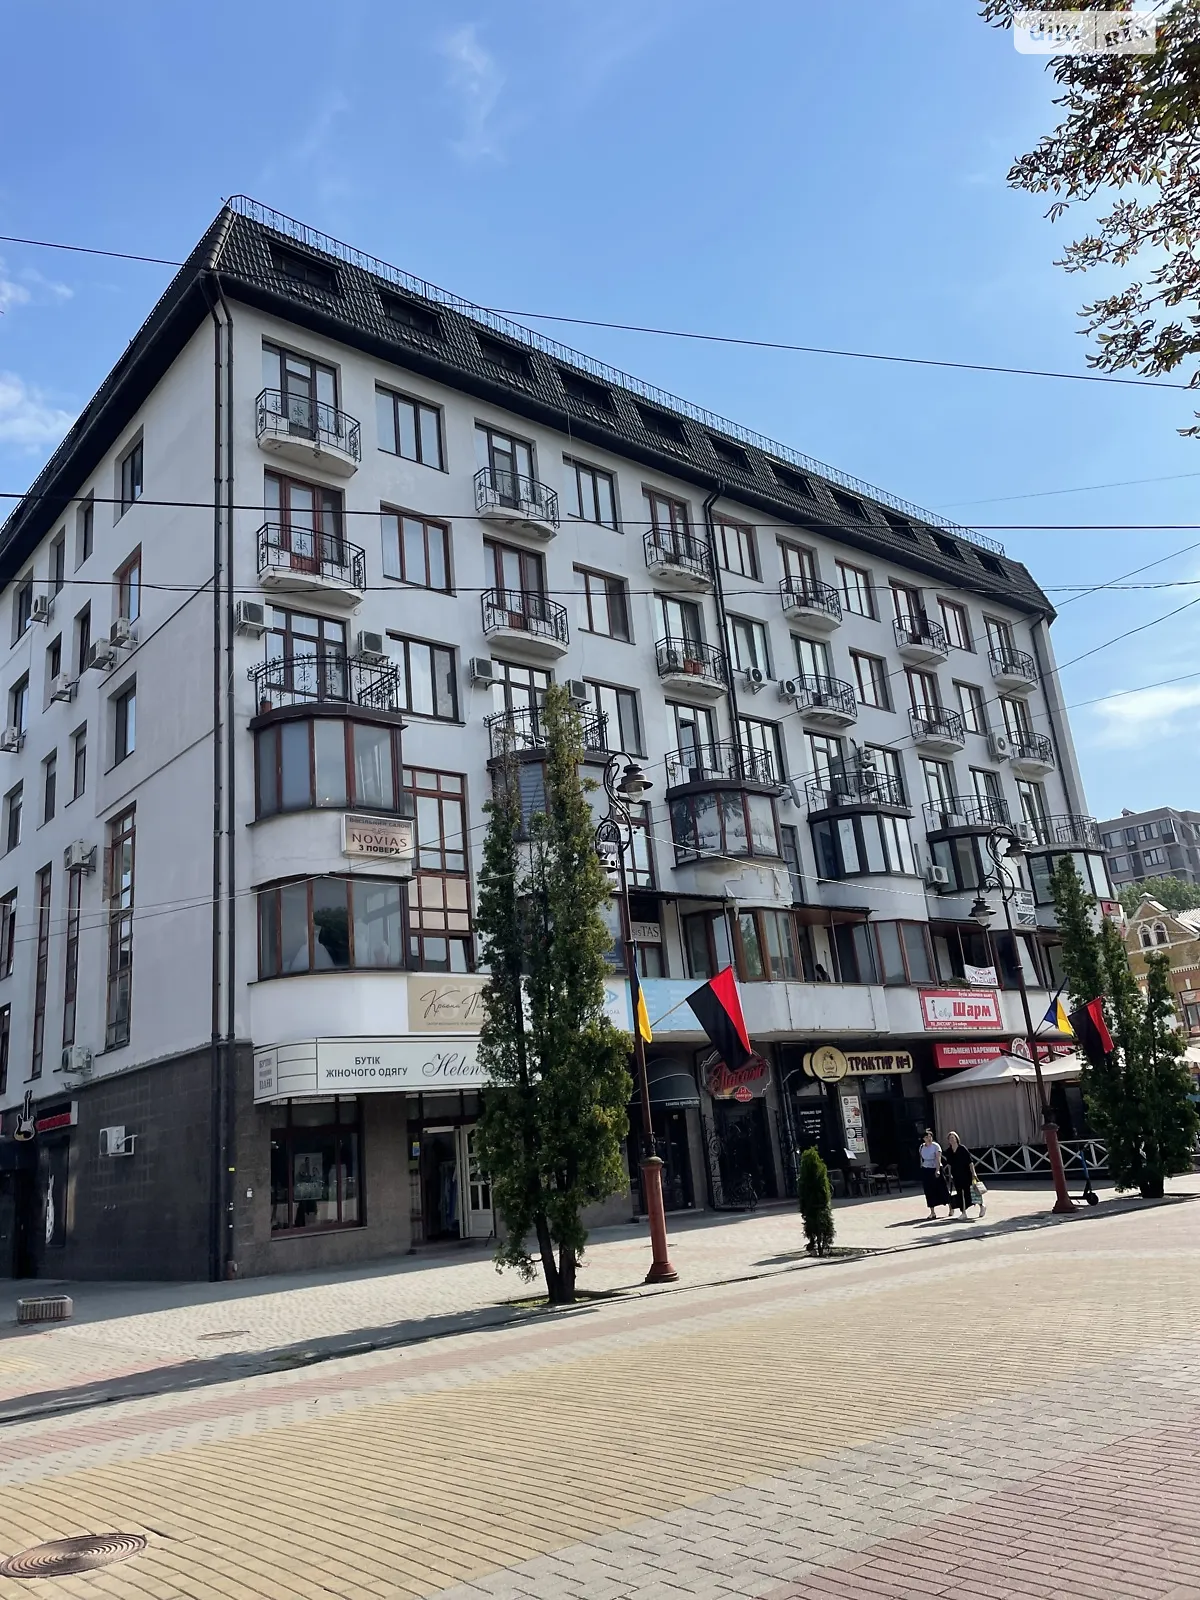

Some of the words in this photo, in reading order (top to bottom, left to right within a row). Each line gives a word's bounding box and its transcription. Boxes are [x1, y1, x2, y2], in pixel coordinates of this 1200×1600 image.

[352, 833, 407, 848] NOVIAS
[366, 845, 400, 854] ПОВЕРХ
[952, 1002, 991, 1019] Шарм
[354, 1056, 381, 1065] БУТІК
[847, 1055, 894, 1072] ТРАКТИР
[326, 1068, 377, 1078] ЖІНОЧОГО
[378, 1067, 408, 1077] ОДЯГУ
